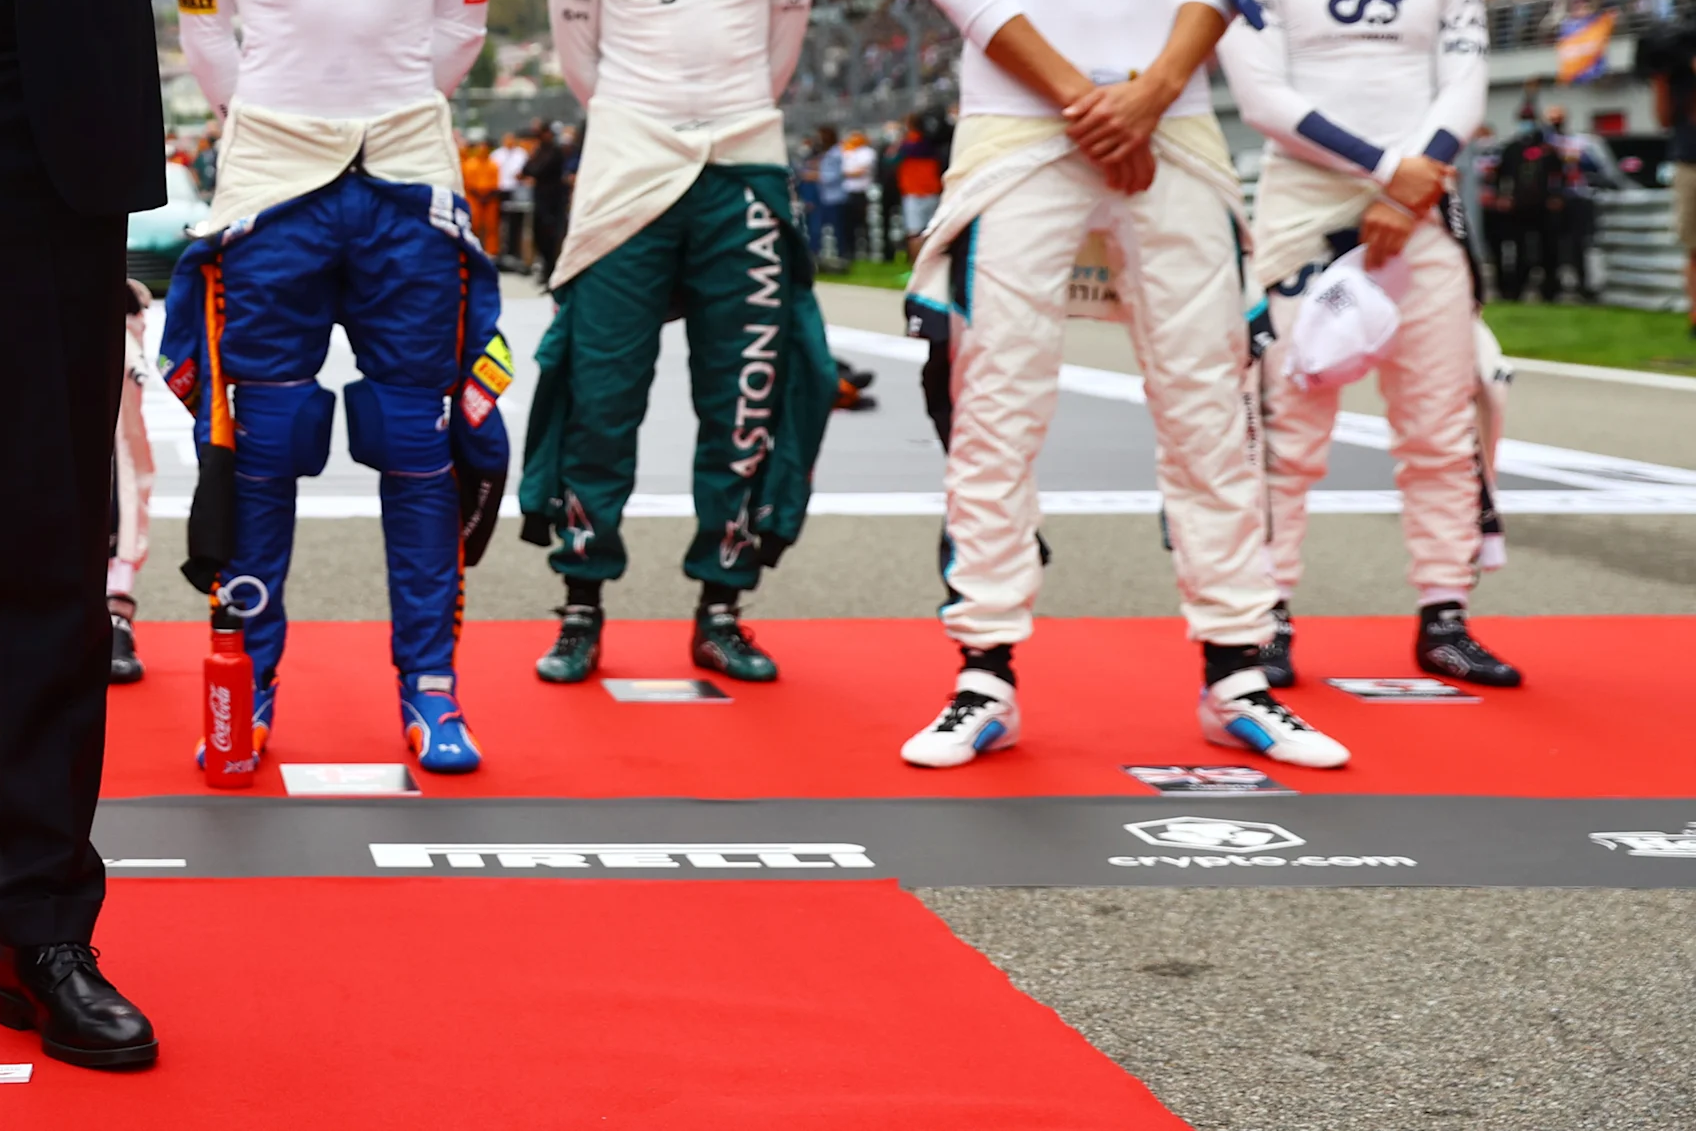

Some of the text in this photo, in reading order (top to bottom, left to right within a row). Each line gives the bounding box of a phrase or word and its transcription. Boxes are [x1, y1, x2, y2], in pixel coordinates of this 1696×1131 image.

[729, 324, 779, 478] ASTON
[368, 842, 875, 868] PIRELLI
[1107, 853, 1418, 869] crypto.com
